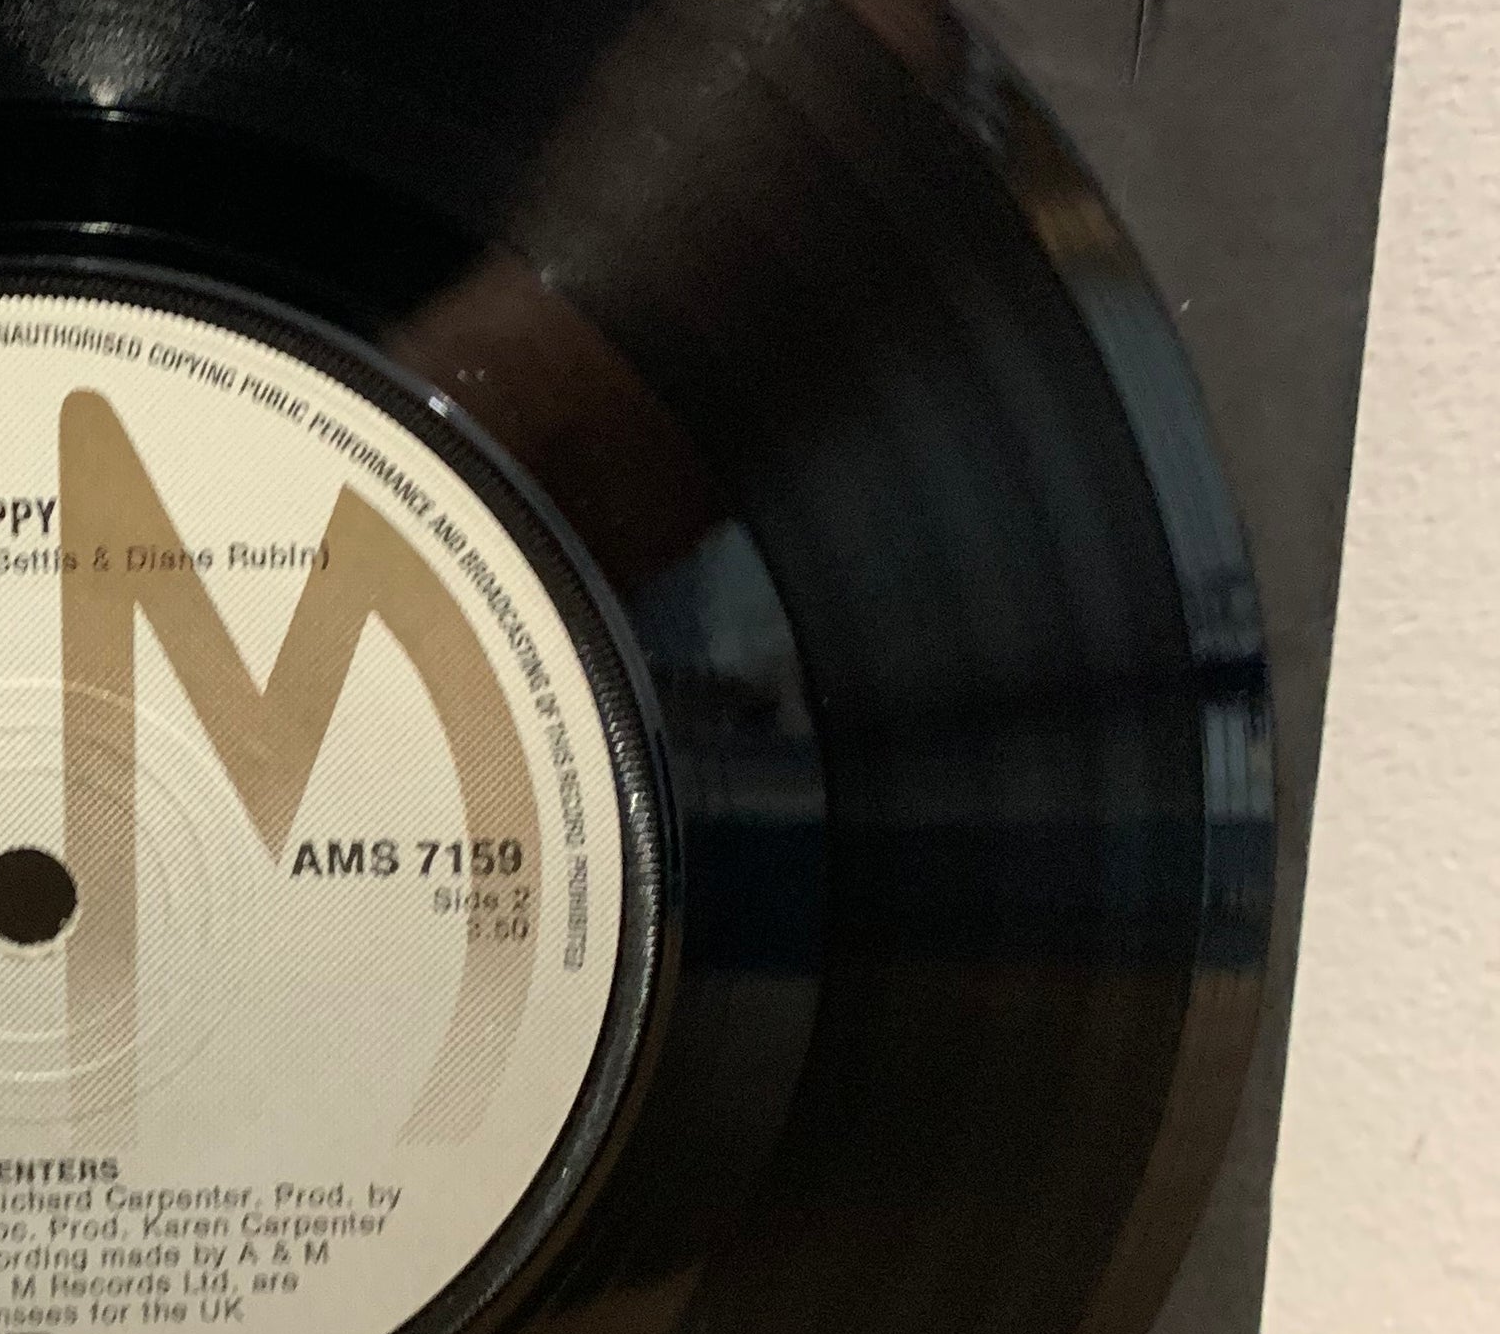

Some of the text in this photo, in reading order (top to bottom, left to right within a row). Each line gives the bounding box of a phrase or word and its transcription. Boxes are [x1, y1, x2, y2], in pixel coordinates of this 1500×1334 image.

[148, 342, 237, 390] COPYING
[239, 374, 309, 423] PUBLIC
[308, 411, 434, 516] PERFORMANCE
[427, 512, 468, 554] AND
[456, 549, 551, 692] BROADCASTING
[535, 693, 560, 718] OF
[92, 543, 111, 573] &
[125, 543, 213, 572] Diane
[226, 538, 330, 571] Rubin)
[289, 837, 523, 880] AMS 7159
[432, 885, 533, 915] Side 2
[367, 1181, 402, 1214] by
[143, 1209, 231, 1240] Karen
[240, 1210, 390, 1241] Carpenter
[100, 1242, 181, 1270] made
[193, 1240, 227, 1269] by
[237, 1238, 261, 1267] A
[272, 1238, 291, 1266] &
[304, 1236, 330, 1266] M
[10, 1270, 38, 1300] M
[49, 1270, 172, 1299] Records
[251, 1270, 300, 1296] are
[90, 1299, 130, 1328] for
[141, 1296, 188, 1326] the
[199, 1293, 245, 1327] UK
